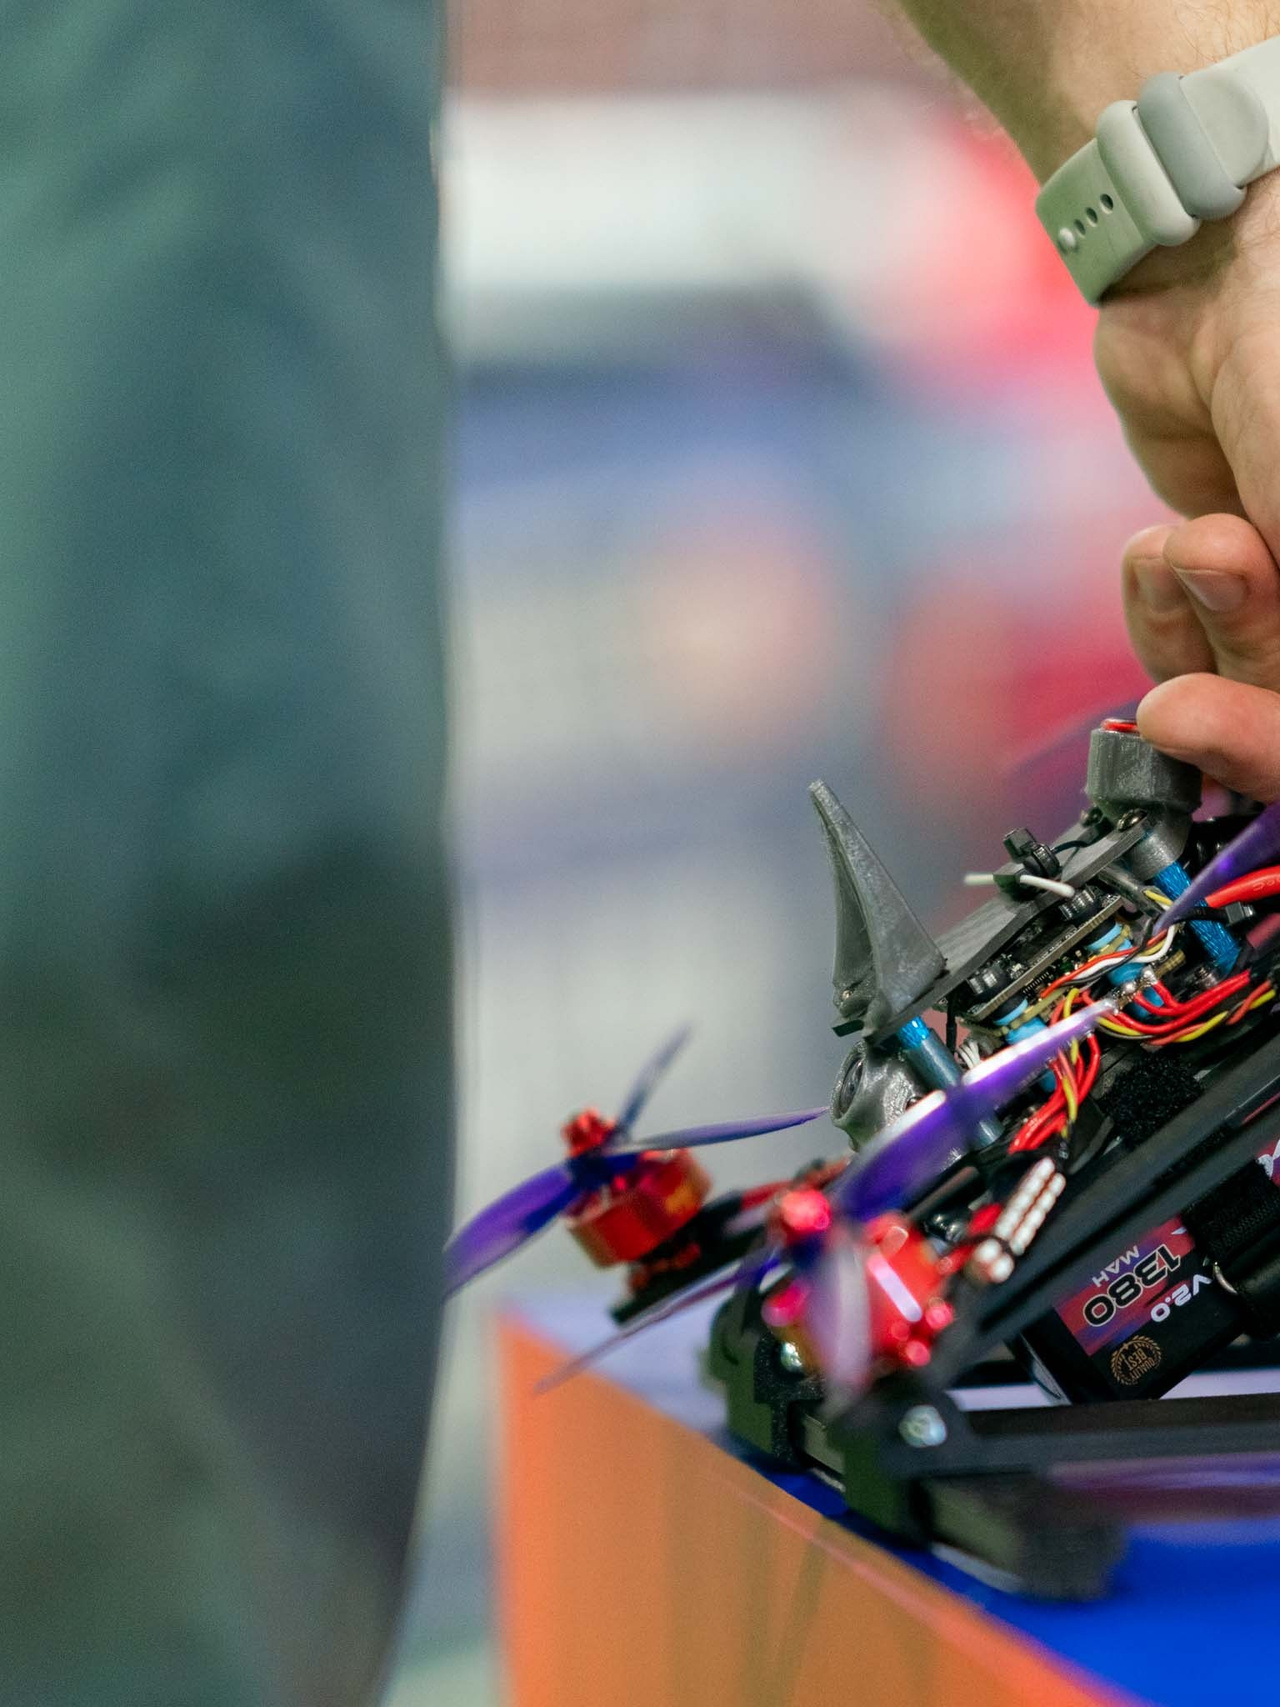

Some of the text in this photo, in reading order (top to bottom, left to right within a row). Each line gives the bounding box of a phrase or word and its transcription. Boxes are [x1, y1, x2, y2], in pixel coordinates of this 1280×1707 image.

[1083, 1244, 1181, 1327] 1380
[1092, 1245, 1139, 1287] MAH
[1151, 1274, 1212, 1322] V2.0
[1121, 1348, 1147, 1370] BEST
[1129, 1357, 1156, 1379] QUALITY
